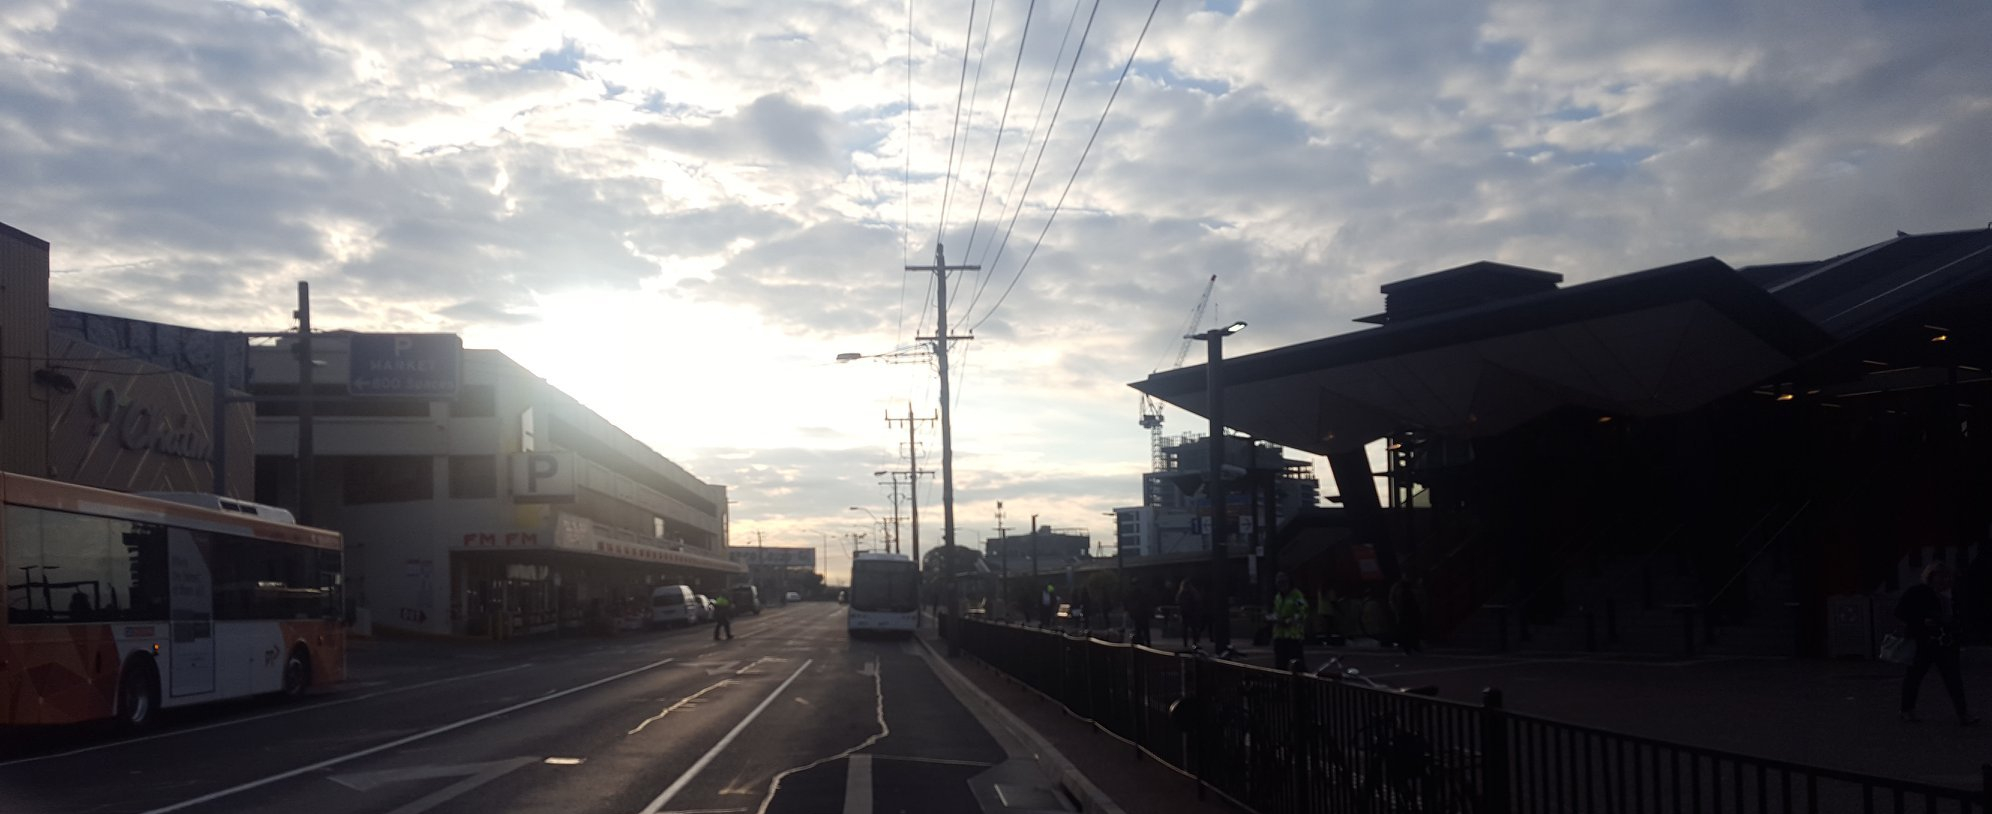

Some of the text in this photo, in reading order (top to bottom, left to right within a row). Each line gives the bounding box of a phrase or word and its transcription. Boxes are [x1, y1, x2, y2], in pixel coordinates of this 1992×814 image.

[394, 336, 412, 357] P
[369, 360, 437, 372] MARKET
[528, 455, 559, 493] P
[463, 531, 538, 546] FM FM
